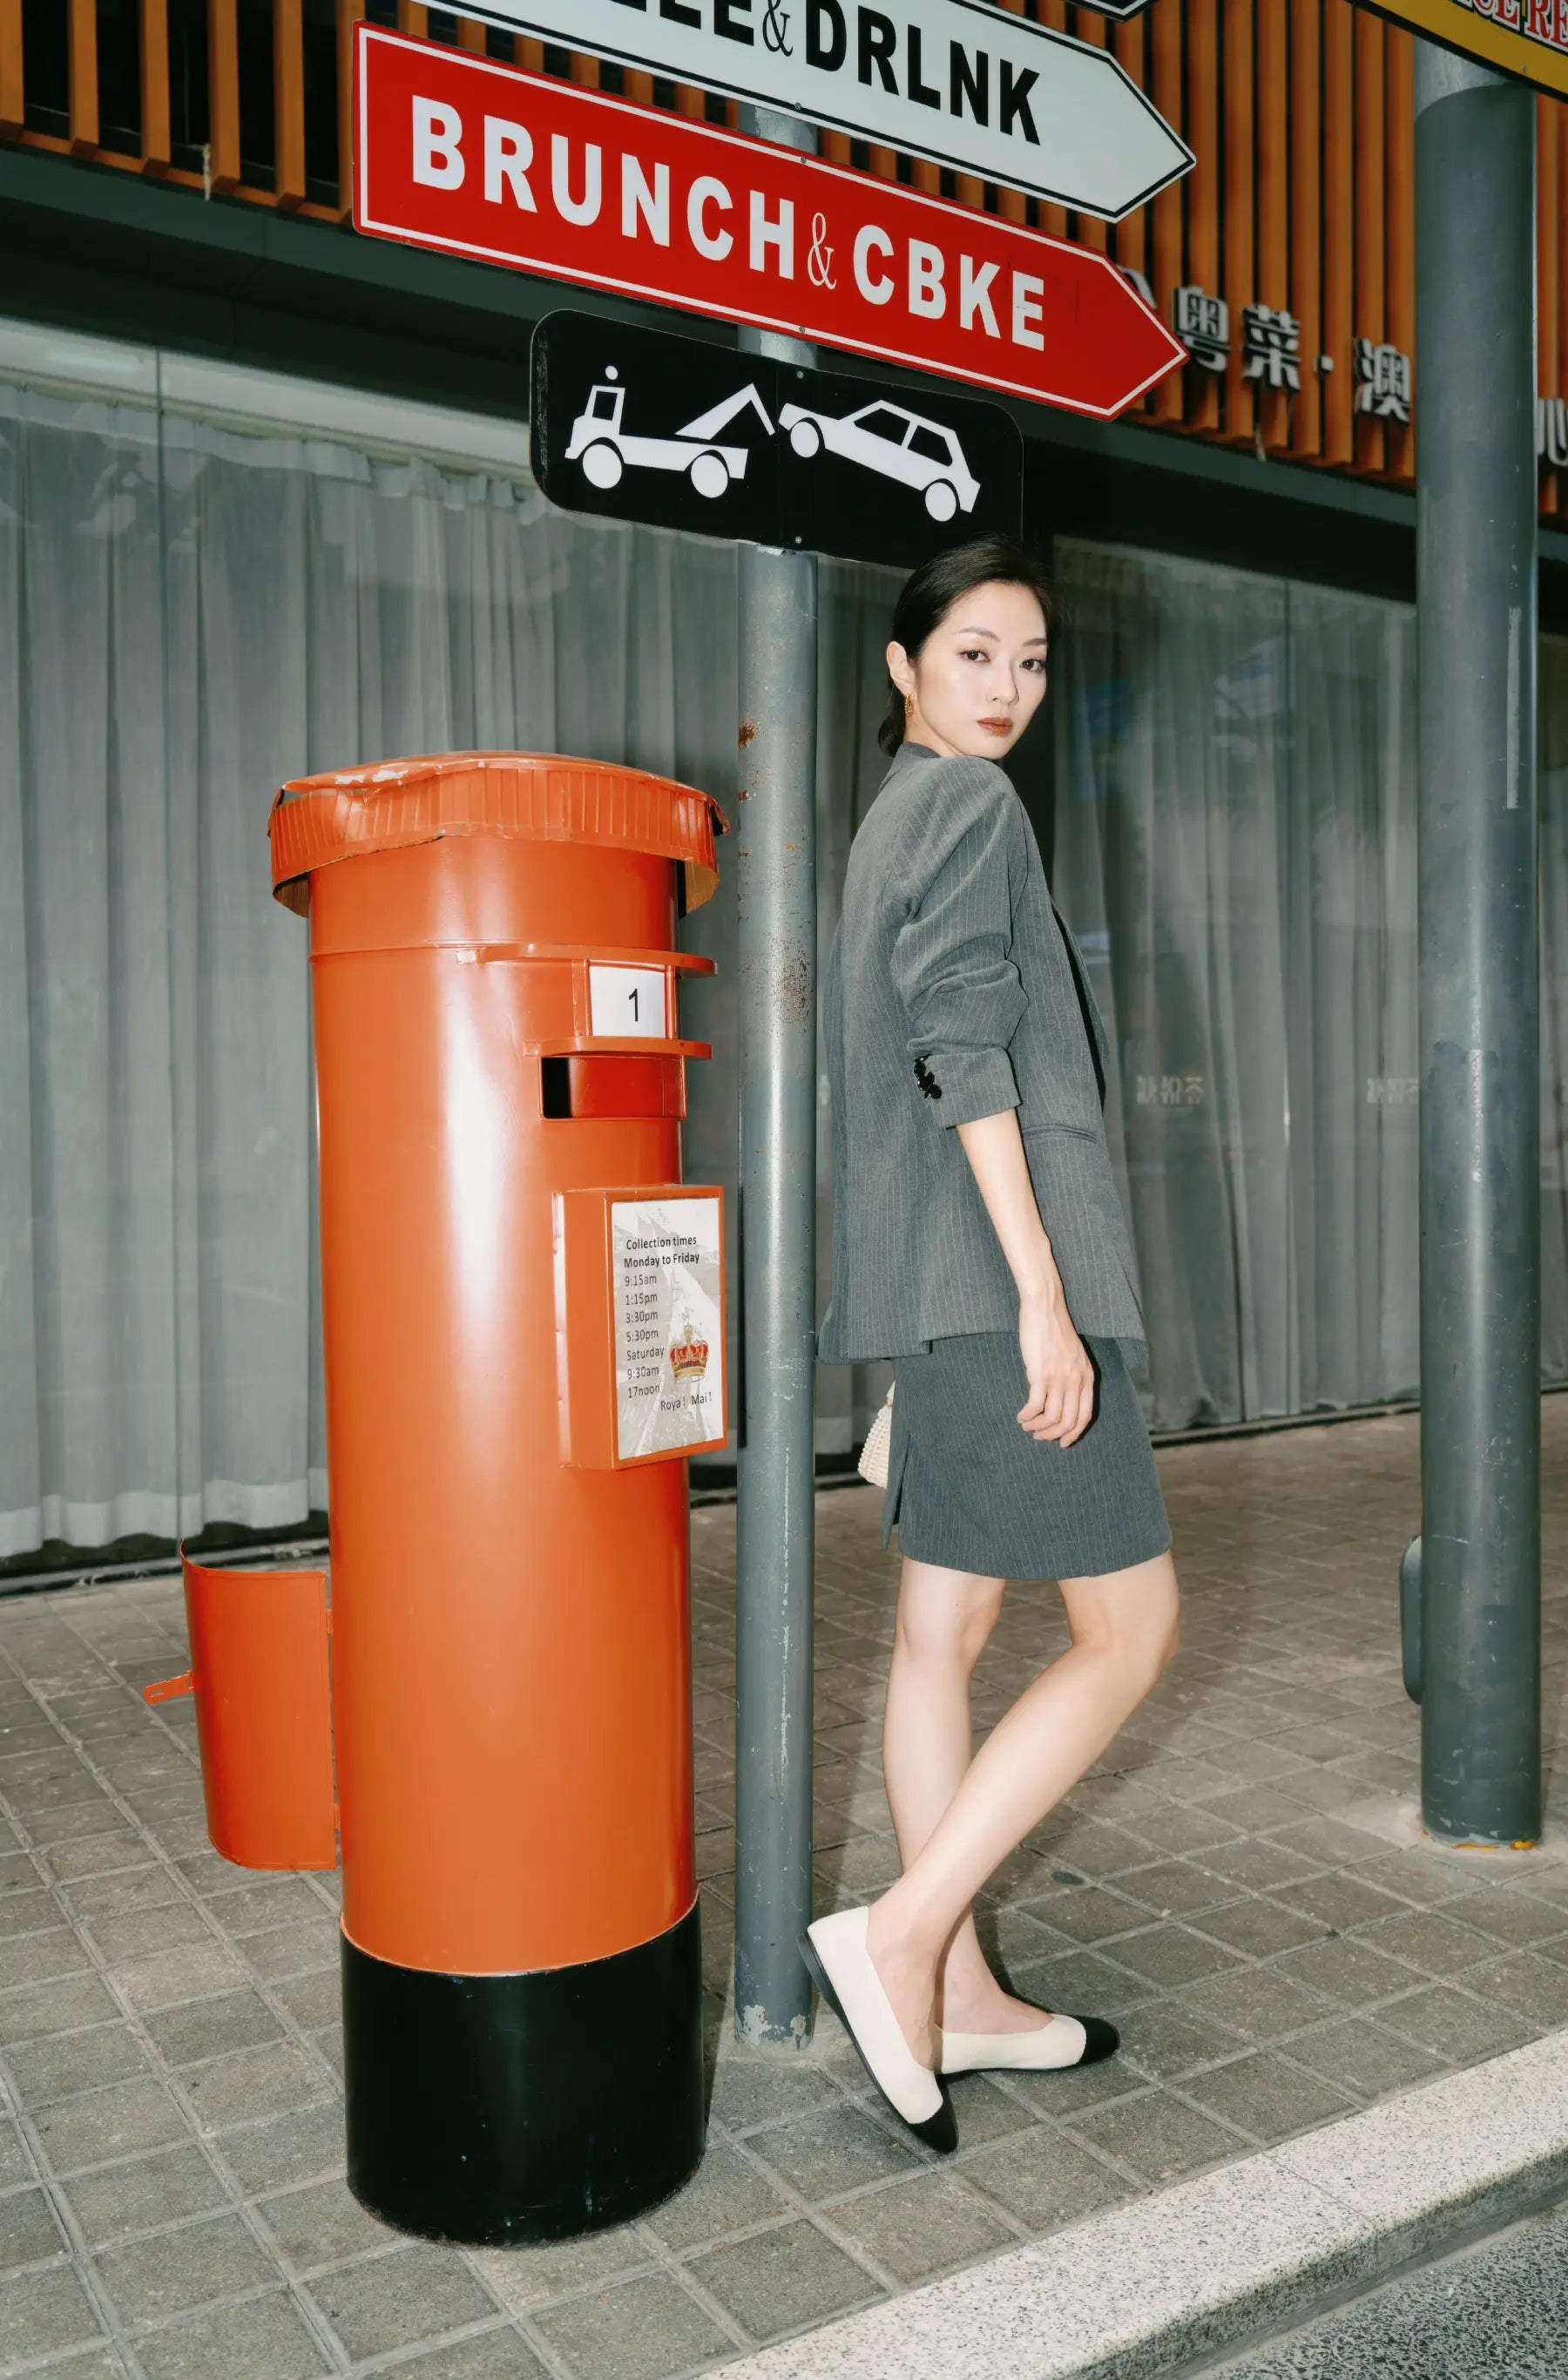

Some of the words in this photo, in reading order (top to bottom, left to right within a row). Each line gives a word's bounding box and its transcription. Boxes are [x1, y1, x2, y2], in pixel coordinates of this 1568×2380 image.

[411, 94, 794, 281] BRUNCH
[807, 212, 837, 292] &
[853, 224, 1045, 352] CBKE
[628, 988, 639, 1022] 1
[626, 1237, 671, 1250] Collection
[672, 1235, 697, 1247] times
[624, 1255, 659, 1268] Monday
[662, 1255, 671, 1265] to
[672, 1252, 700, 1264] Friday
[625, 1274, 657, 1287] 9:15am
[625, 1293, 658, 1306] 1:15pm
[625, 1311, 659, 1324] 3:30pm
[626, 1329, 659, 1342] 5:30pm
[627, 1346, 665, 1361] Saturday
[627, 1366, 659, 1380] 9:30am
